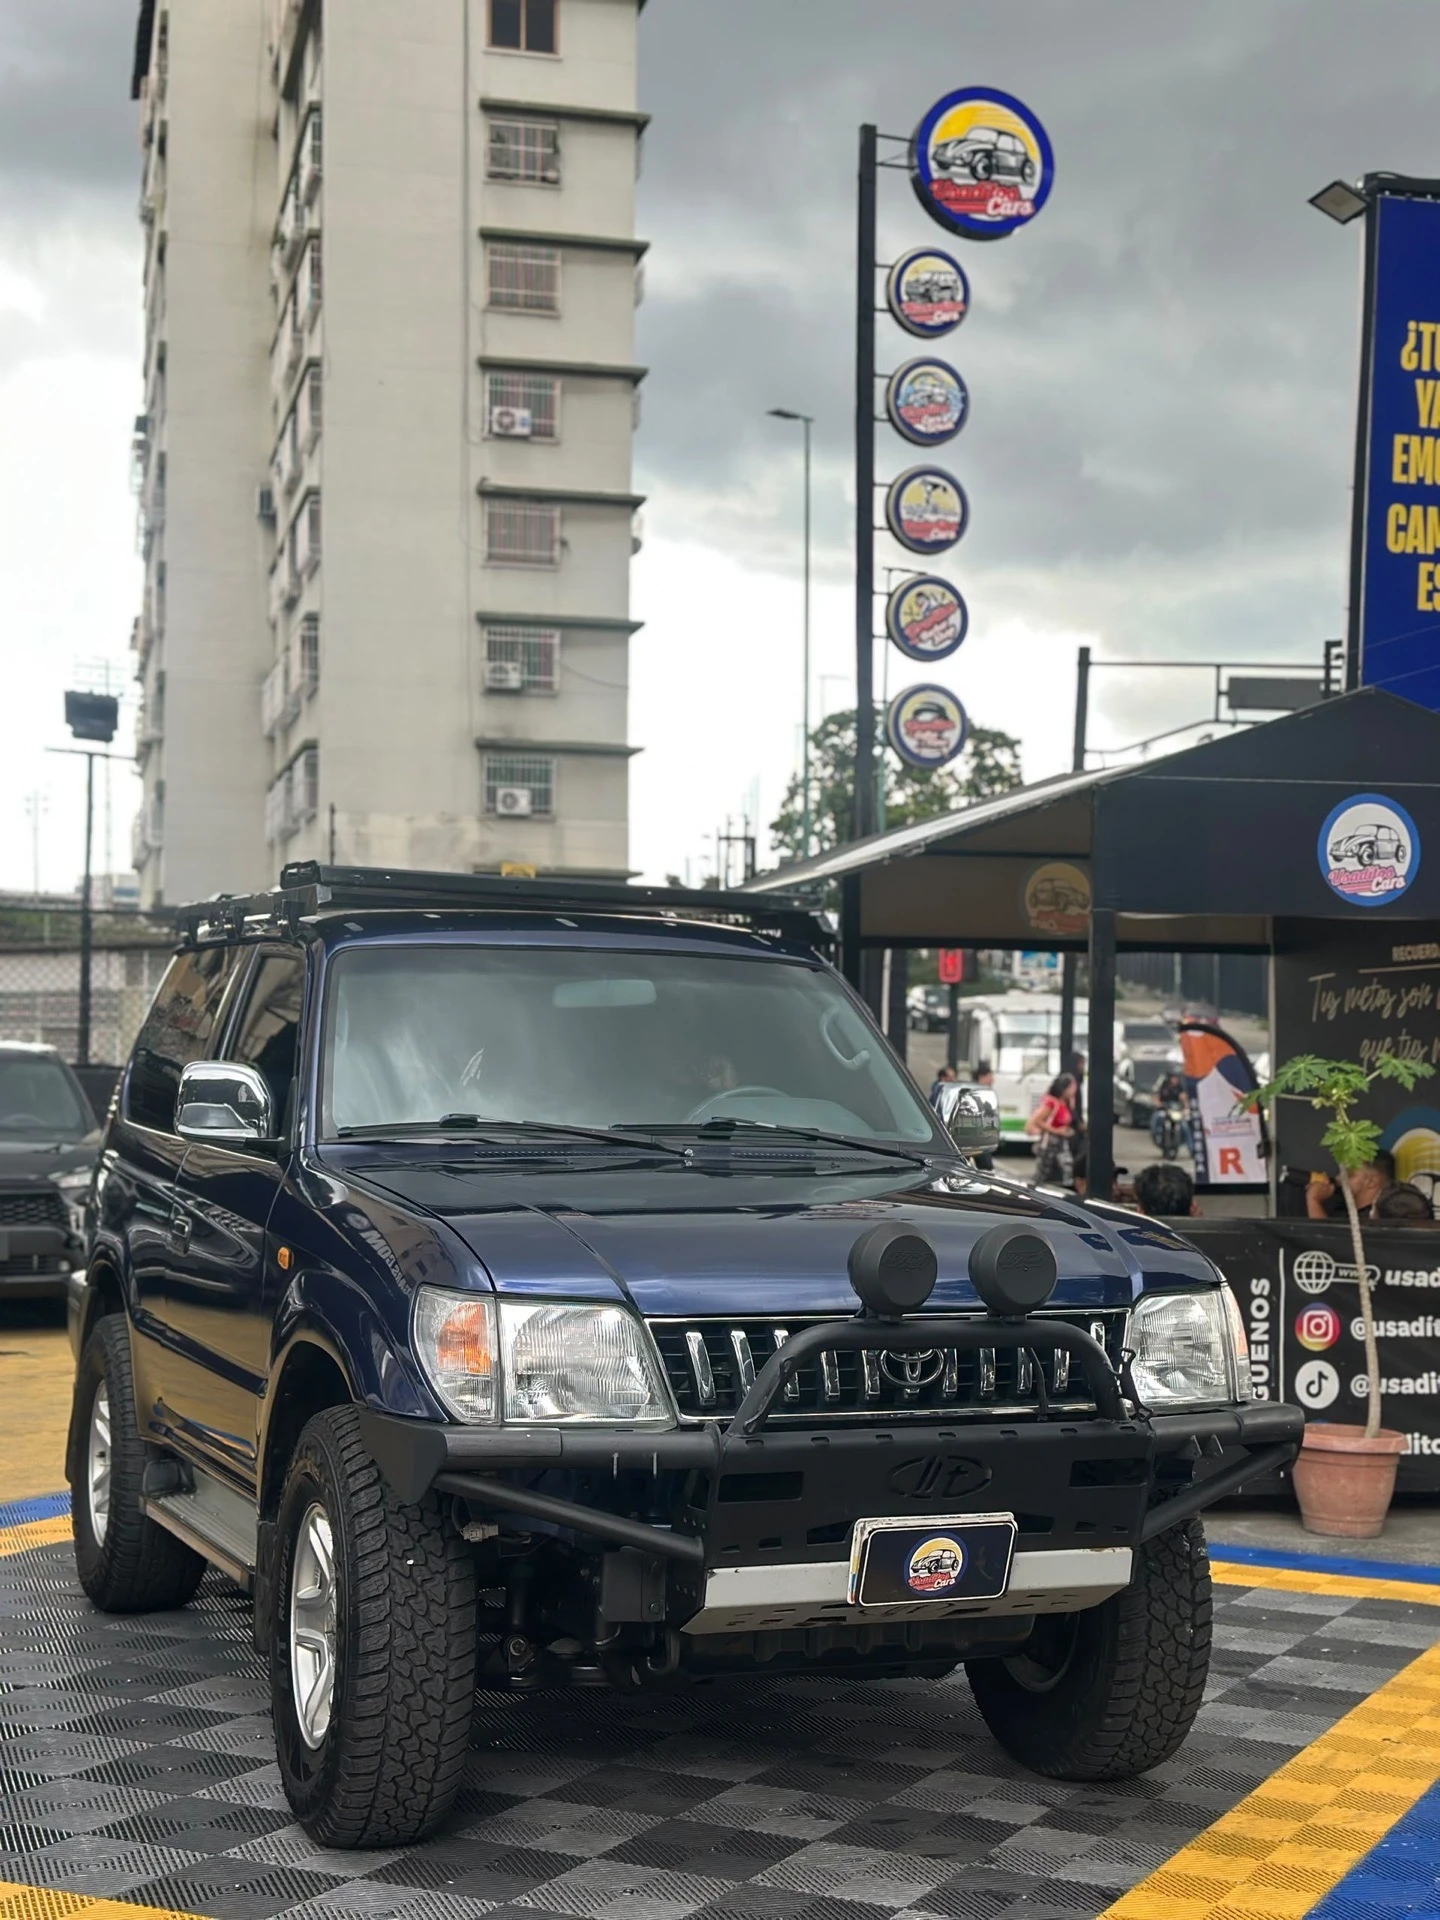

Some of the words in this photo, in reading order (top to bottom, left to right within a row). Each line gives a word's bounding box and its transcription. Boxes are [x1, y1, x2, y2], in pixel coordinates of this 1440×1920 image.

[986, 197, 1034, 216] Cars
[1327, 864, 1396, 886] Usaditos
[1371, 876, 1406, 893] Cars
[1218, 1146, 1244, 1175] R
[933, 1577, 956, 1588] Cars
